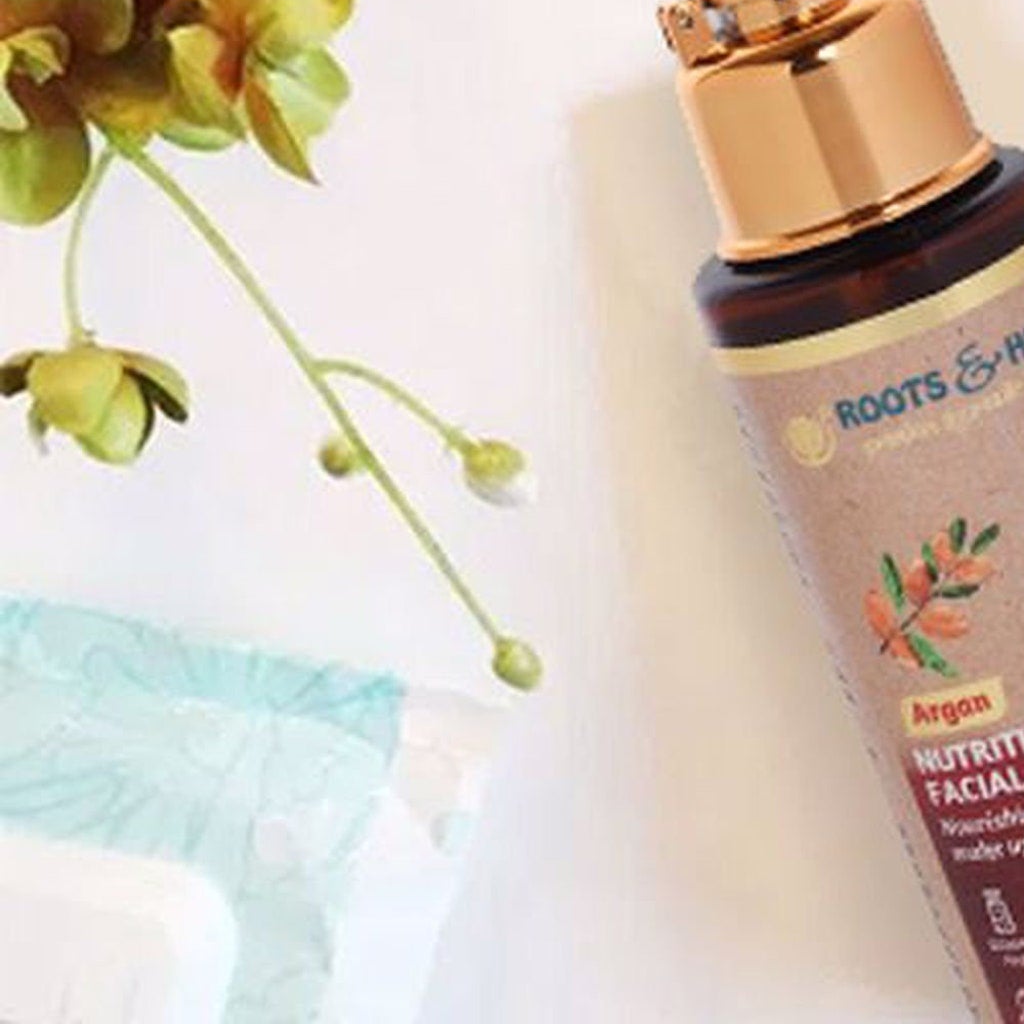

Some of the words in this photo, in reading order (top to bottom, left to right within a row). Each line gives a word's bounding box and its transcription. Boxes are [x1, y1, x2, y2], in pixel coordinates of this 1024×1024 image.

[835, 370, 949, 430] ROOTS
[954, 343, 1006, 397] &
[911, 692, 993, 725] Argan
